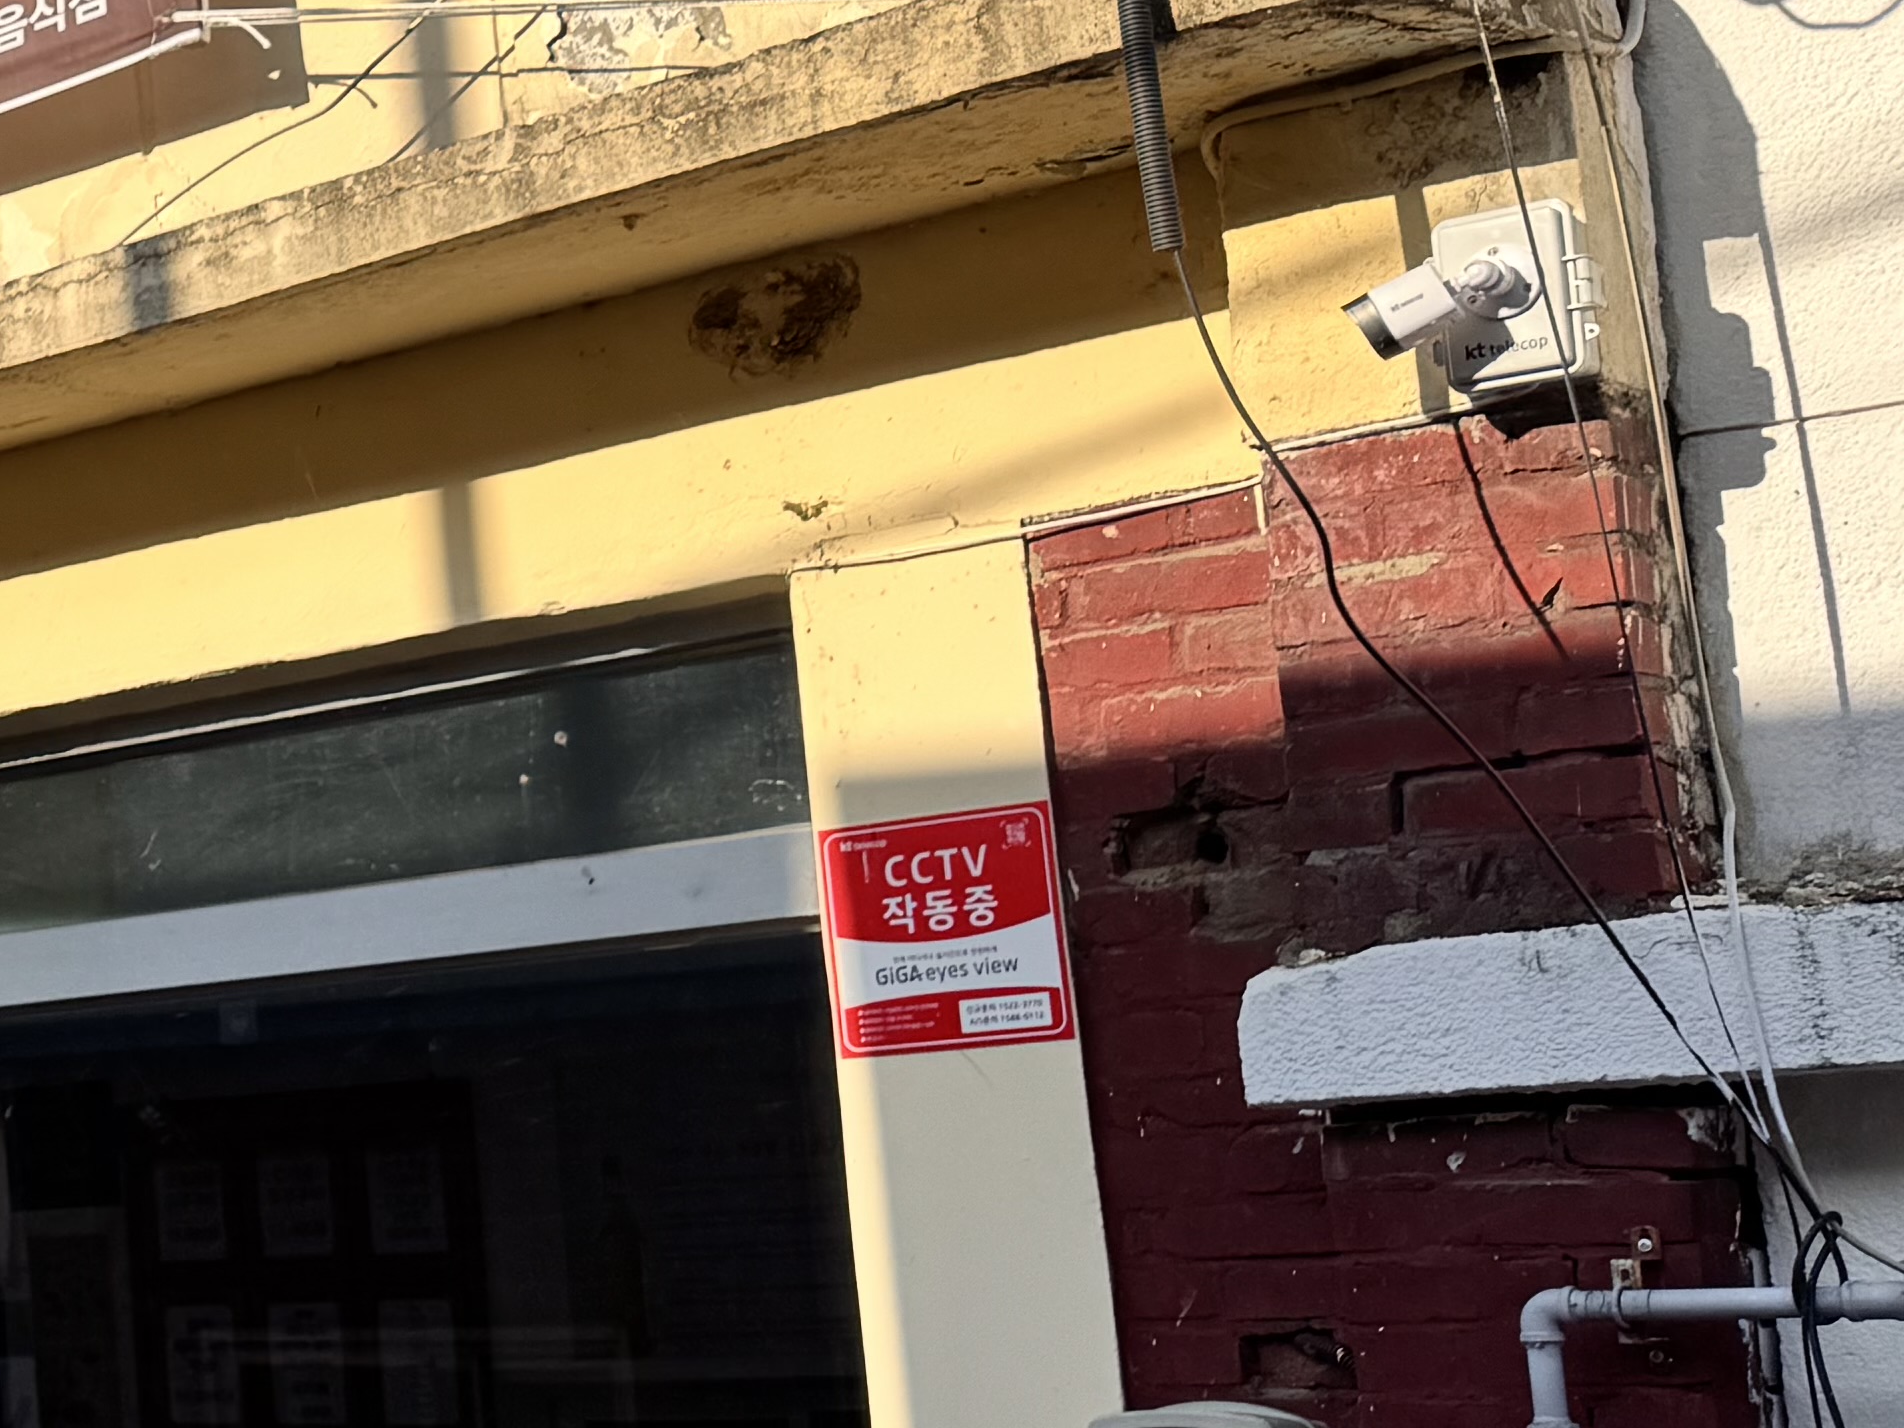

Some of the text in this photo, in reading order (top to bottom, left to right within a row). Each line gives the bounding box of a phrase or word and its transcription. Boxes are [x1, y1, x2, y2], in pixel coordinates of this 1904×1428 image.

[1465, 335, 1549, 361] kt telecop
[884, 844, 987, 887] CCTV
[882, 884, 998, 934] 작동중
[973, 956, 1019, 976] view
